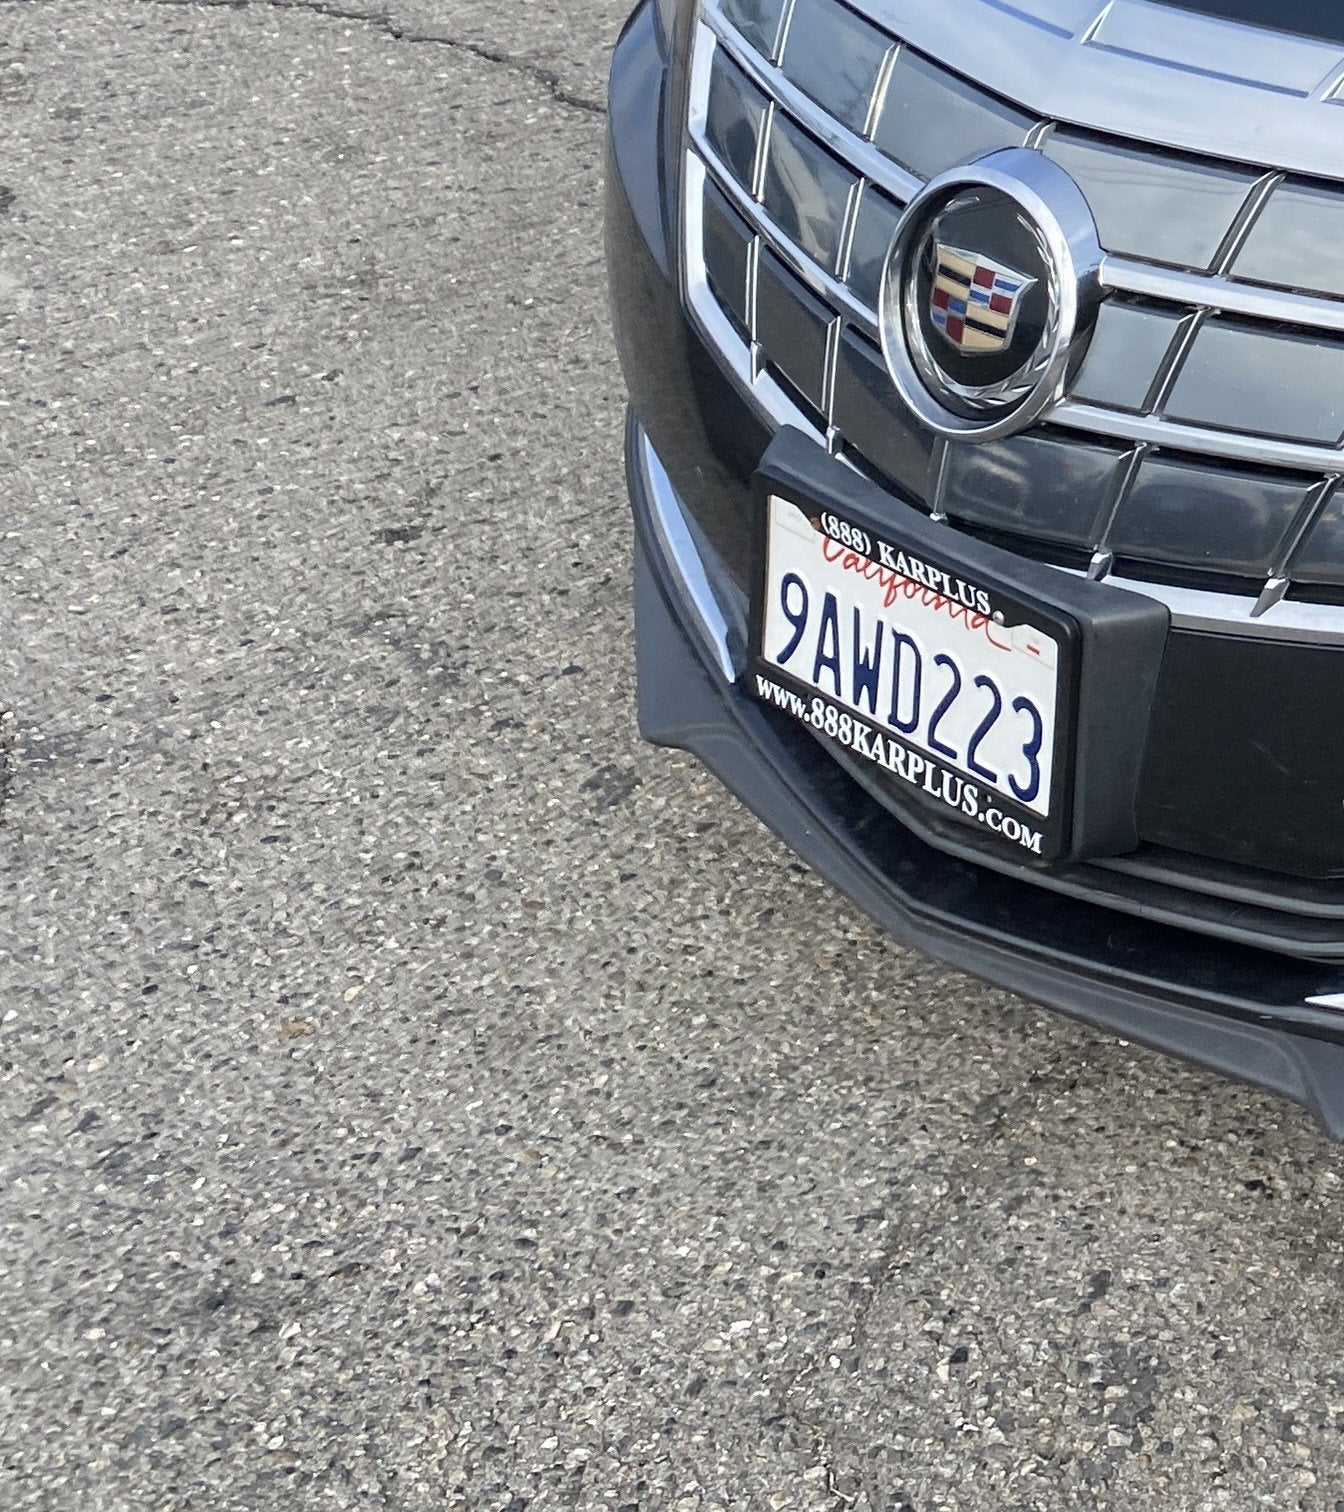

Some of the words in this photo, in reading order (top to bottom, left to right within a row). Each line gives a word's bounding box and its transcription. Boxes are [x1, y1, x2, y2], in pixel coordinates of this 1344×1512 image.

[820, 512, 871, 557] (888)
[877, 540, 991, 615] KARPLUS
[776, 572, 1044, 803] 9AWD223
